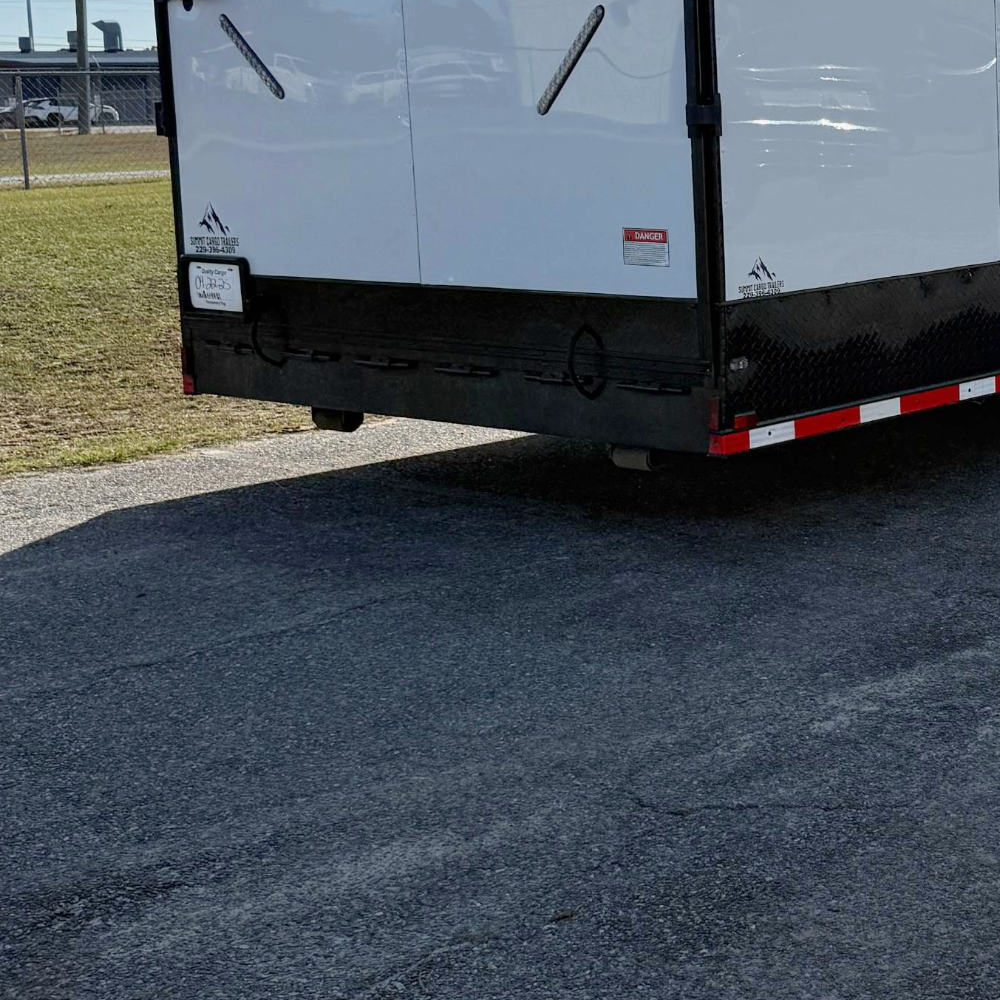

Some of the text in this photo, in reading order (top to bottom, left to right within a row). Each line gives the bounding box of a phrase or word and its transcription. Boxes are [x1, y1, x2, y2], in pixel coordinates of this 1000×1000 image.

[190, 236, 239, 247] SUMMIT CARGO TRAILERS
[634, 231, 663, 241] DANGER
[738, 280, 785, 293] SUMMIT CARGO TRAILERS
